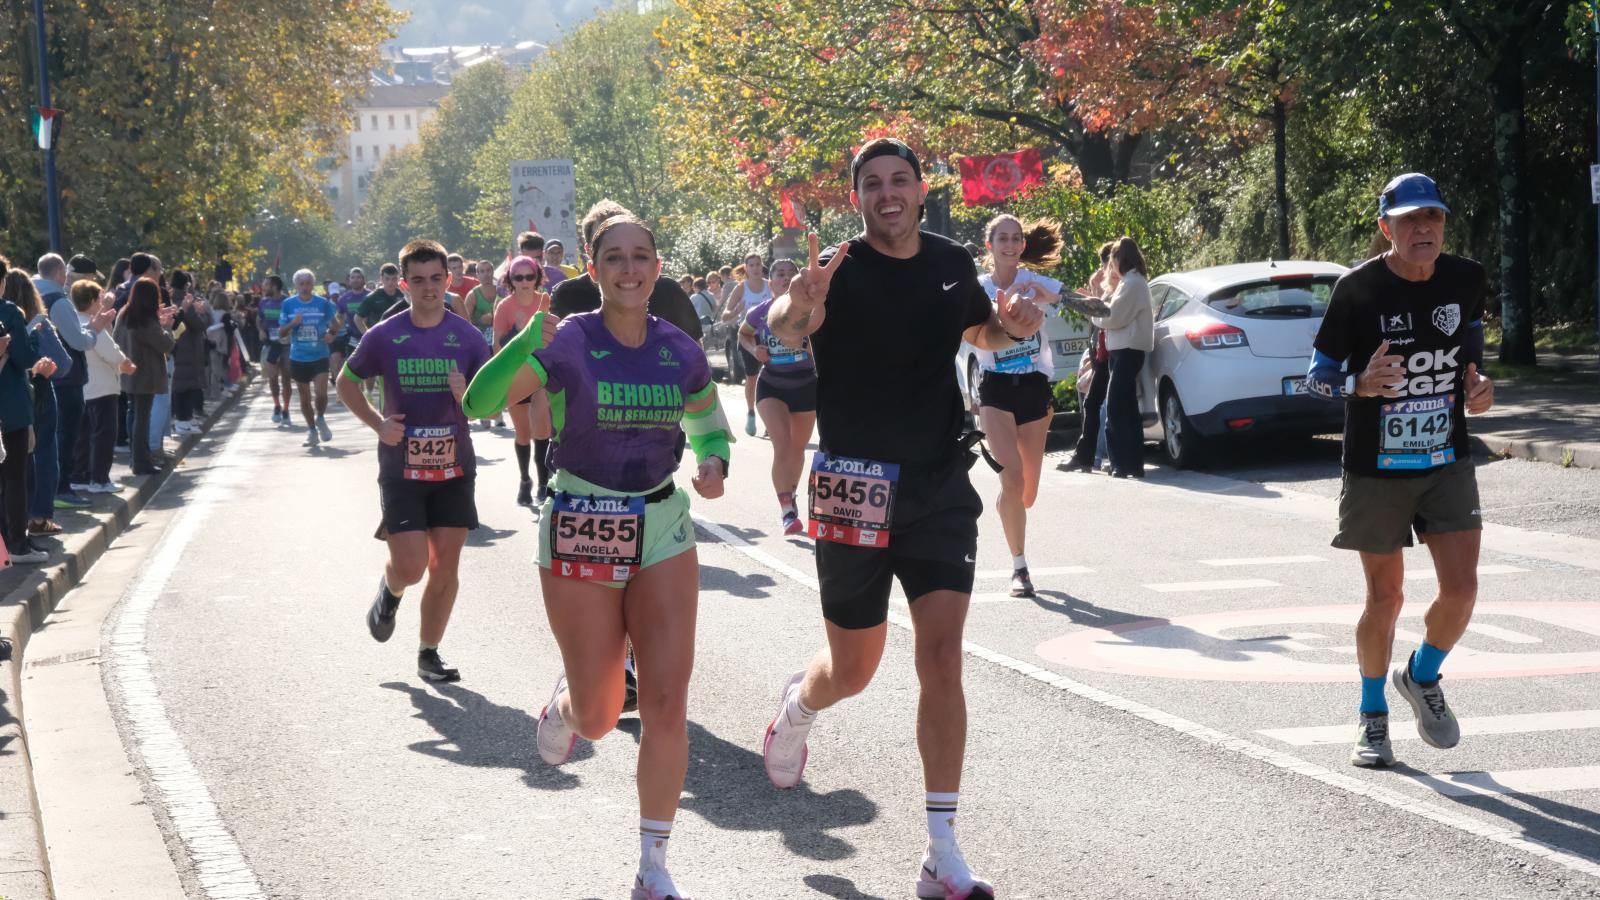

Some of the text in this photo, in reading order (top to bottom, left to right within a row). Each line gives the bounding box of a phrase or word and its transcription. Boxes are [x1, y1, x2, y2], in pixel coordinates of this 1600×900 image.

[521, 164, 571, 177] ERRENTERIA
[397, 358, 458, 375] BEHOBIA
[399, 376, 416, 386] SAN
[597, 380, 684, 407] BEHOBIA
[597, 408, 623, 422] SAN
[1387, 412, 1449, 438] 6142
[409, 438, 455, 456] 3427
[1402, 438, 1435, 448] EMILIO
[816, 475, 889, 509] 5456
[832, 506, 863, 519] DAVID
[558, 515, 637, 543] 5455
[573, 542, 620, 556] ÁNGELA
